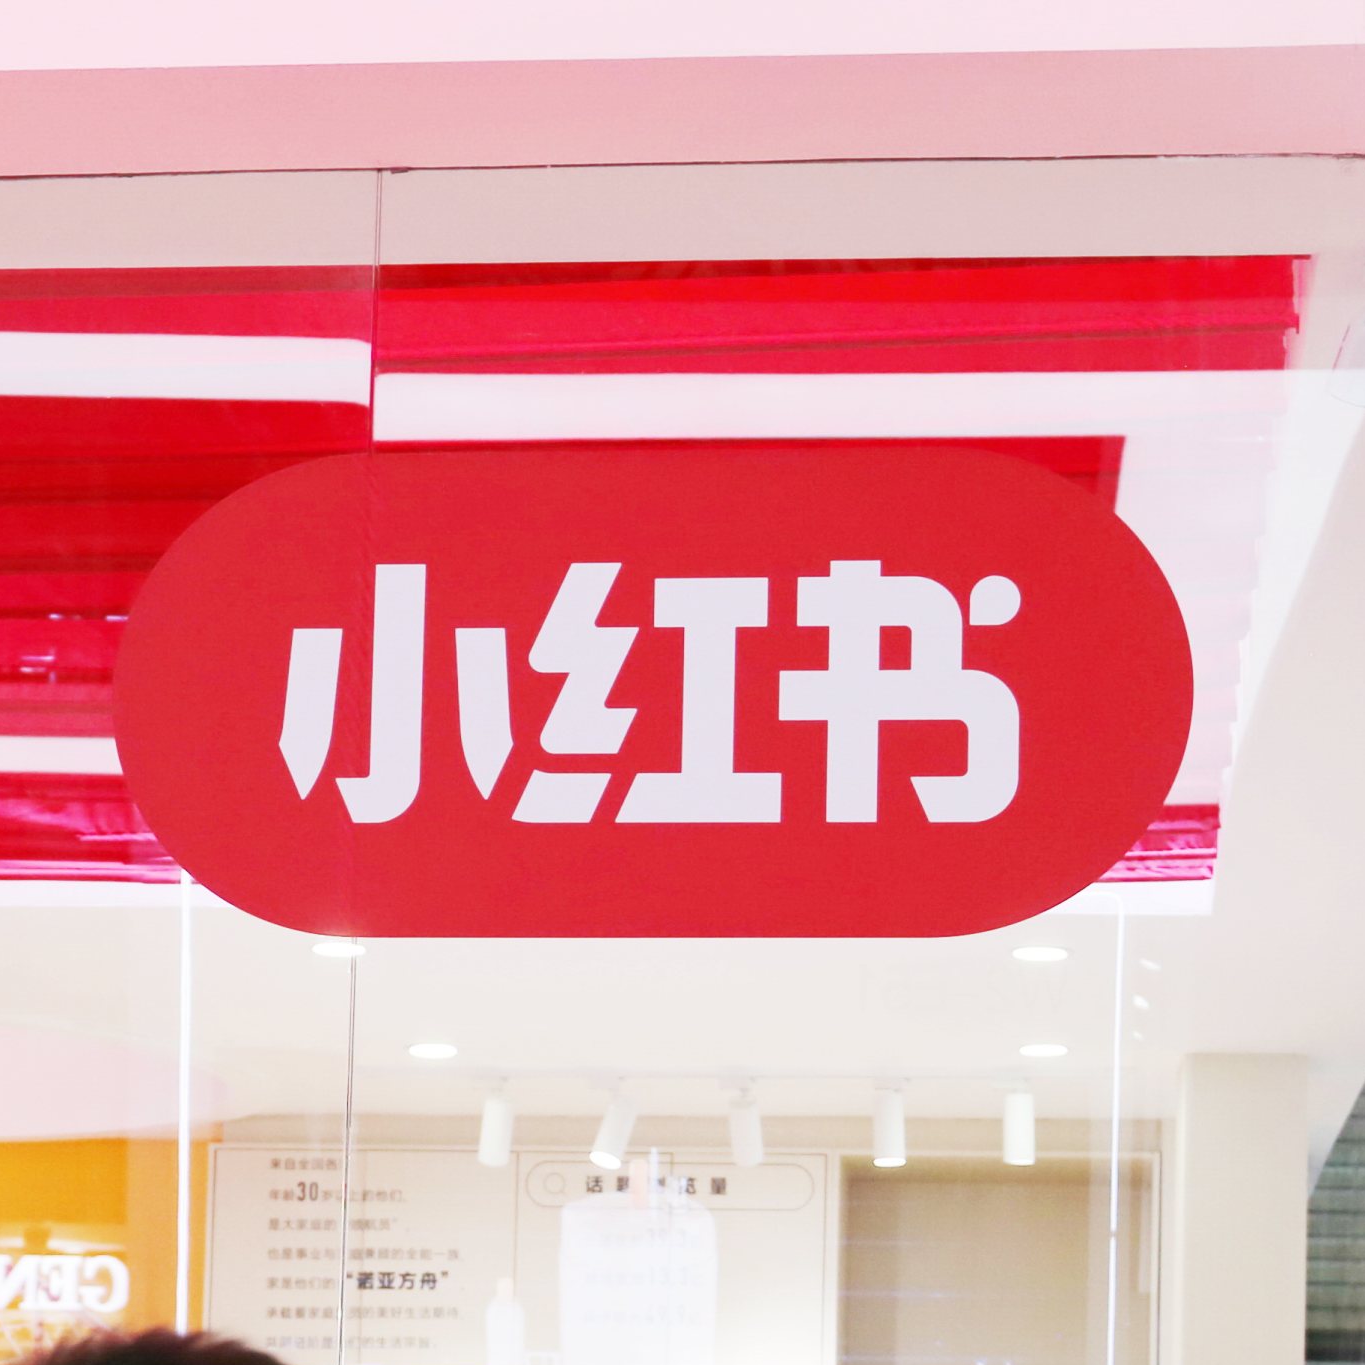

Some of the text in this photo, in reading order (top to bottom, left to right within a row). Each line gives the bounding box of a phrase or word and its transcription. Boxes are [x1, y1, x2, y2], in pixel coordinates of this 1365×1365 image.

[279, 560, 1021, 823] 小红书
[270, 1157, 344, 1170] 来自全国各
[586, 1175, 727, 1195] 话题览量
